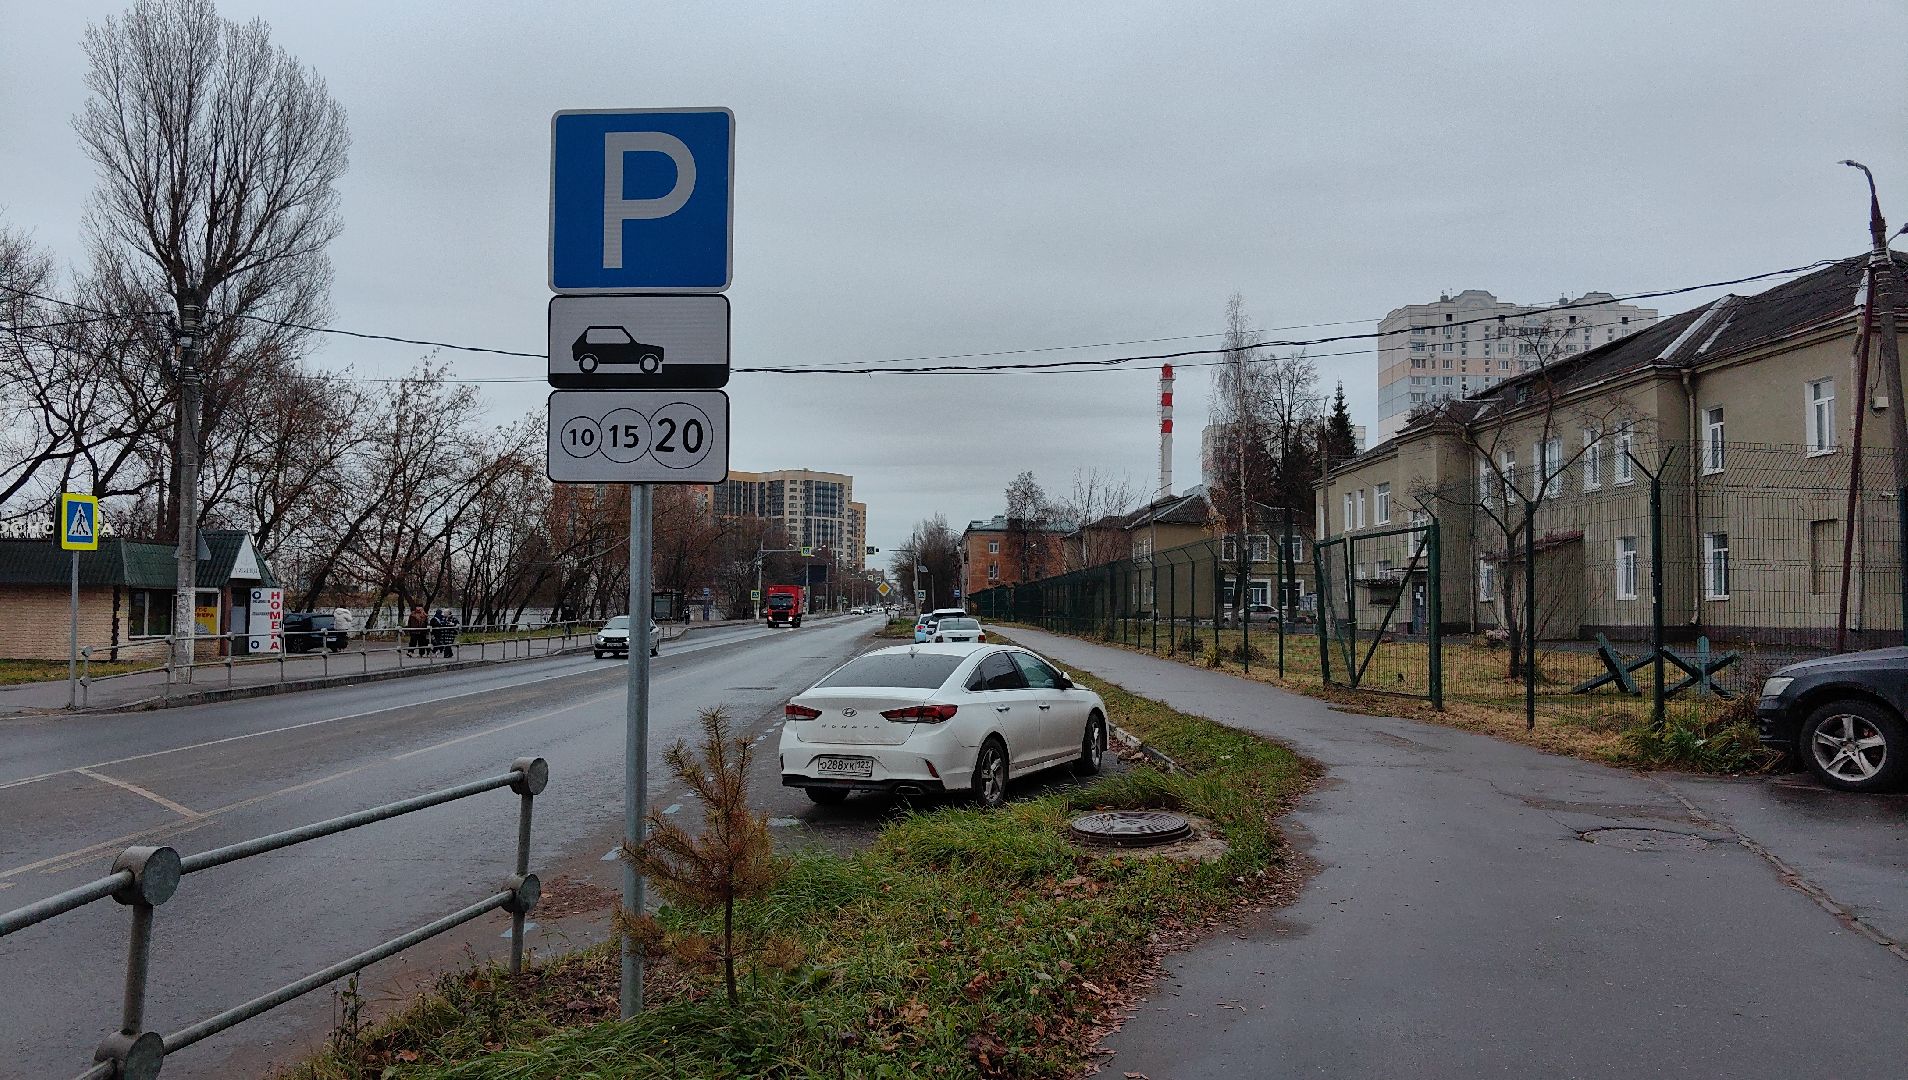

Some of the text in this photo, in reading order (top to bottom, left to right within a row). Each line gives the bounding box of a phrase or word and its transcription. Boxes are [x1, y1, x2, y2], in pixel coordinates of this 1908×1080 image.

[602, 131, 697, 270] P
[568, 417, 704, 454] 10 15 20
